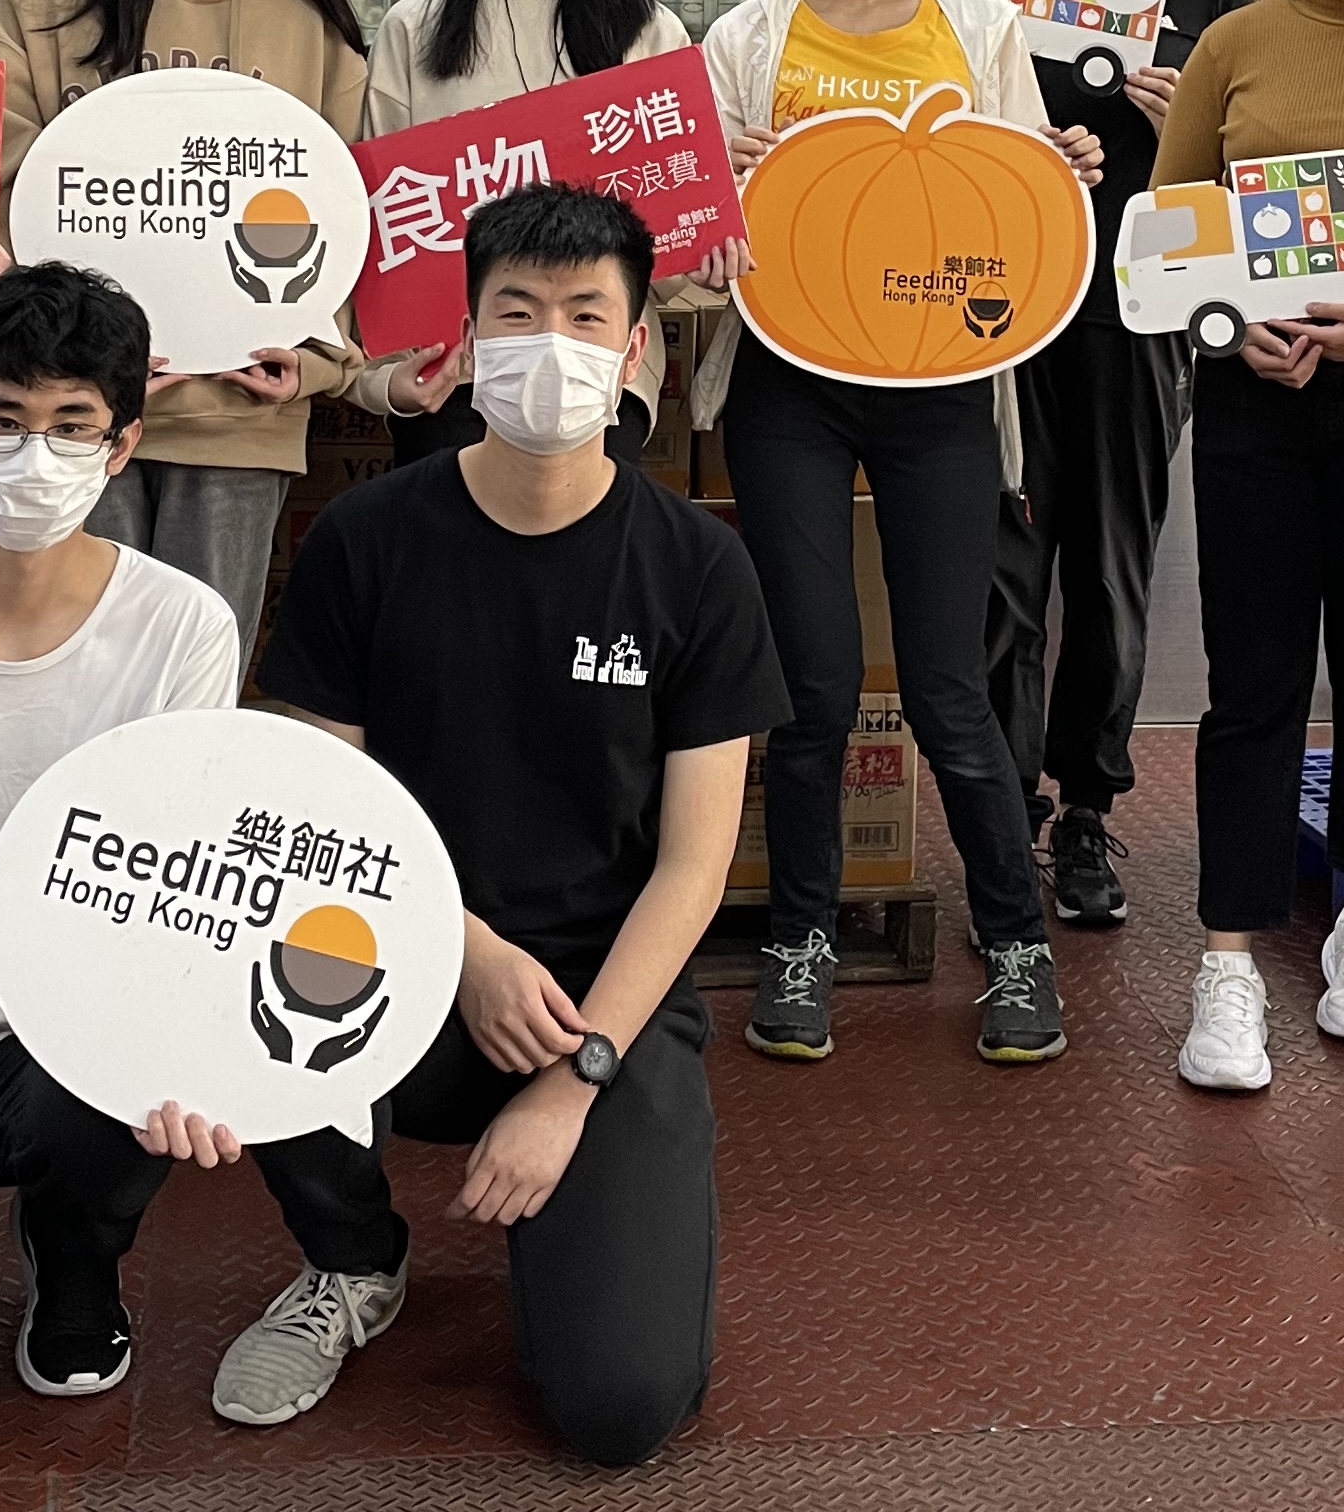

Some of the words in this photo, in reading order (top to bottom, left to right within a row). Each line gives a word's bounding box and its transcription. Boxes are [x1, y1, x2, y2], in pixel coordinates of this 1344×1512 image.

[817, 74, 922, 103] HKUST
[582, 88, 696, 155] 珍惜,
[180, 135, 309, 179] 樂餉社
[597, 150, 711, 202] 不浪費.
[57, 166, 231, 218] Feeding
[57, 209, 128, 240] Hong
[139, 209, 207, 240] Kong
[652, 225, 697, 248] eeding
[882, 268, 968, 296] Feeding
[882, 289, 917, 305] Hong
[921, 290, 955, 306] Kong
[54, 806, 285, 929] Feeding
[223, 806, 401, 902] 樂餉社
[43, 863, 136, 925] Hong
[148, 891, 238, 952] Kong
